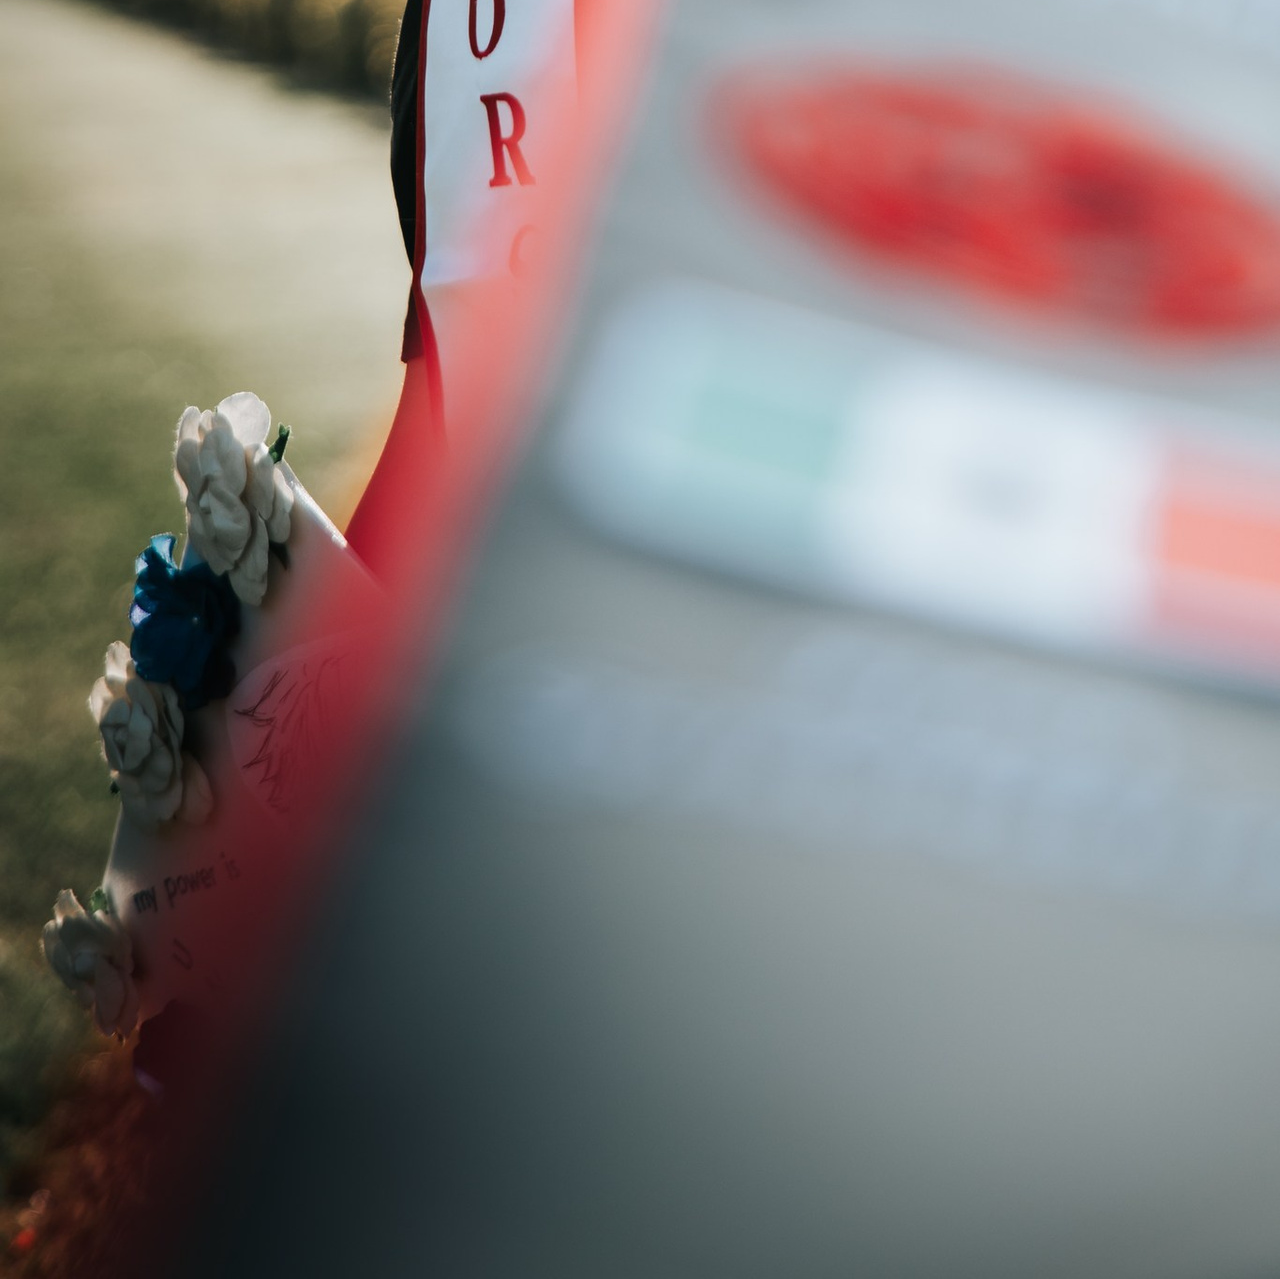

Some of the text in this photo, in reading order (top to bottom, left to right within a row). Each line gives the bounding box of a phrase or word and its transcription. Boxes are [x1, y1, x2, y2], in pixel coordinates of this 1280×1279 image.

[133, 851, 241, 914] my power is
